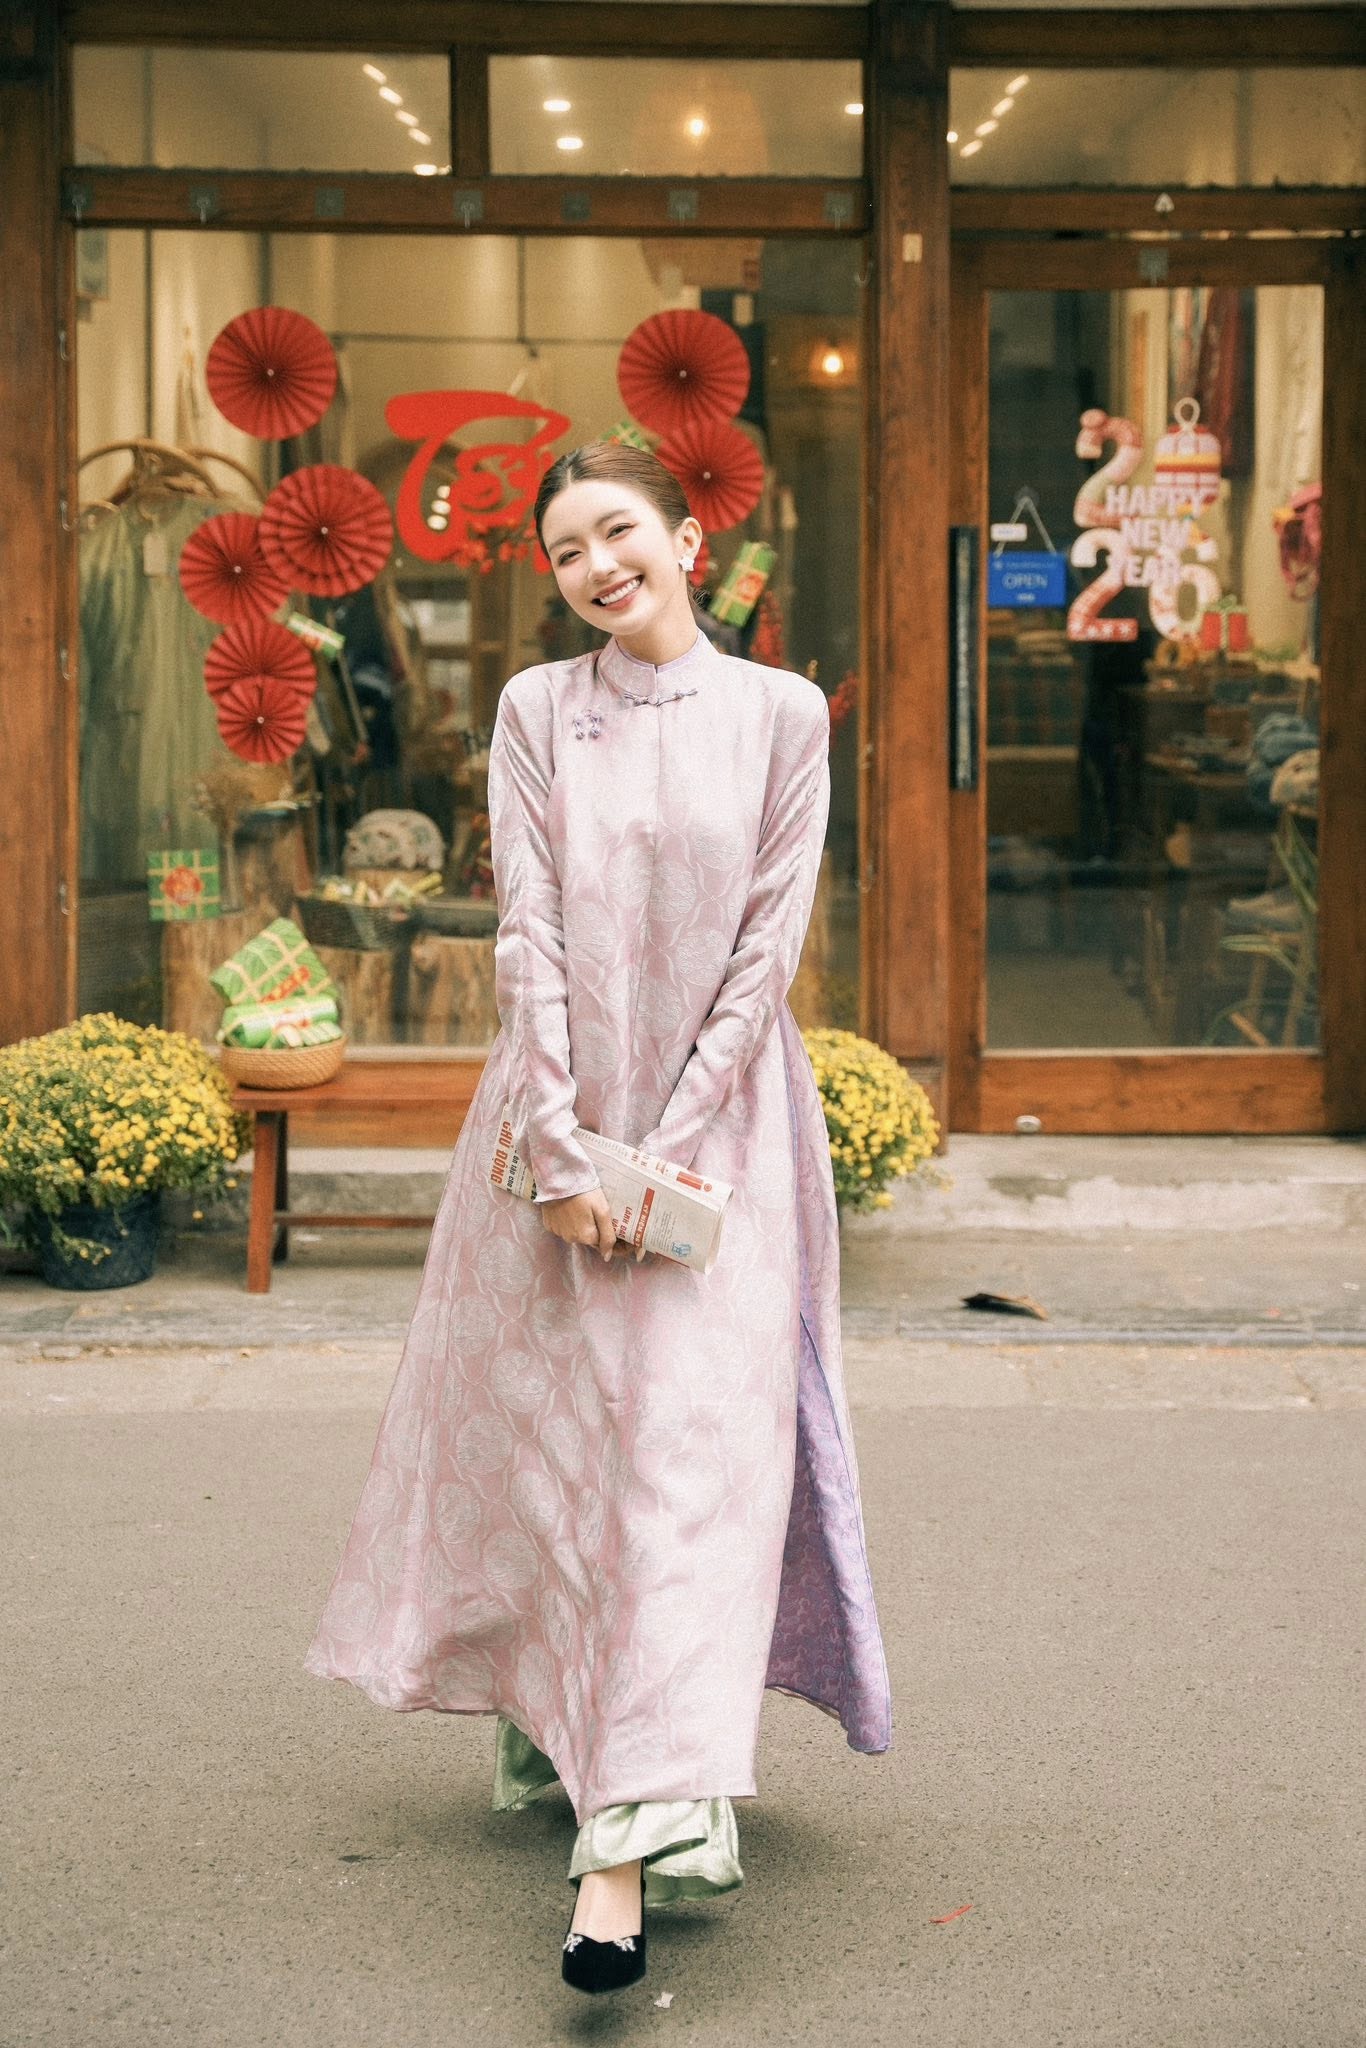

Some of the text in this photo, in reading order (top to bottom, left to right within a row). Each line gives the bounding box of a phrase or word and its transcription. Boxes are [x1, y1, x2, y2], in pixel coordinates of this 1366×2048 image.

[1105, 484, 1205, 519] HAPPY
[1121, 518, 1191, 551] NEW
[1002, 572, 1048, 590] OPEN
[1106, 553, 1182, 588] YEAR
[491, 1149, 508, 1184] ĐỘNG
